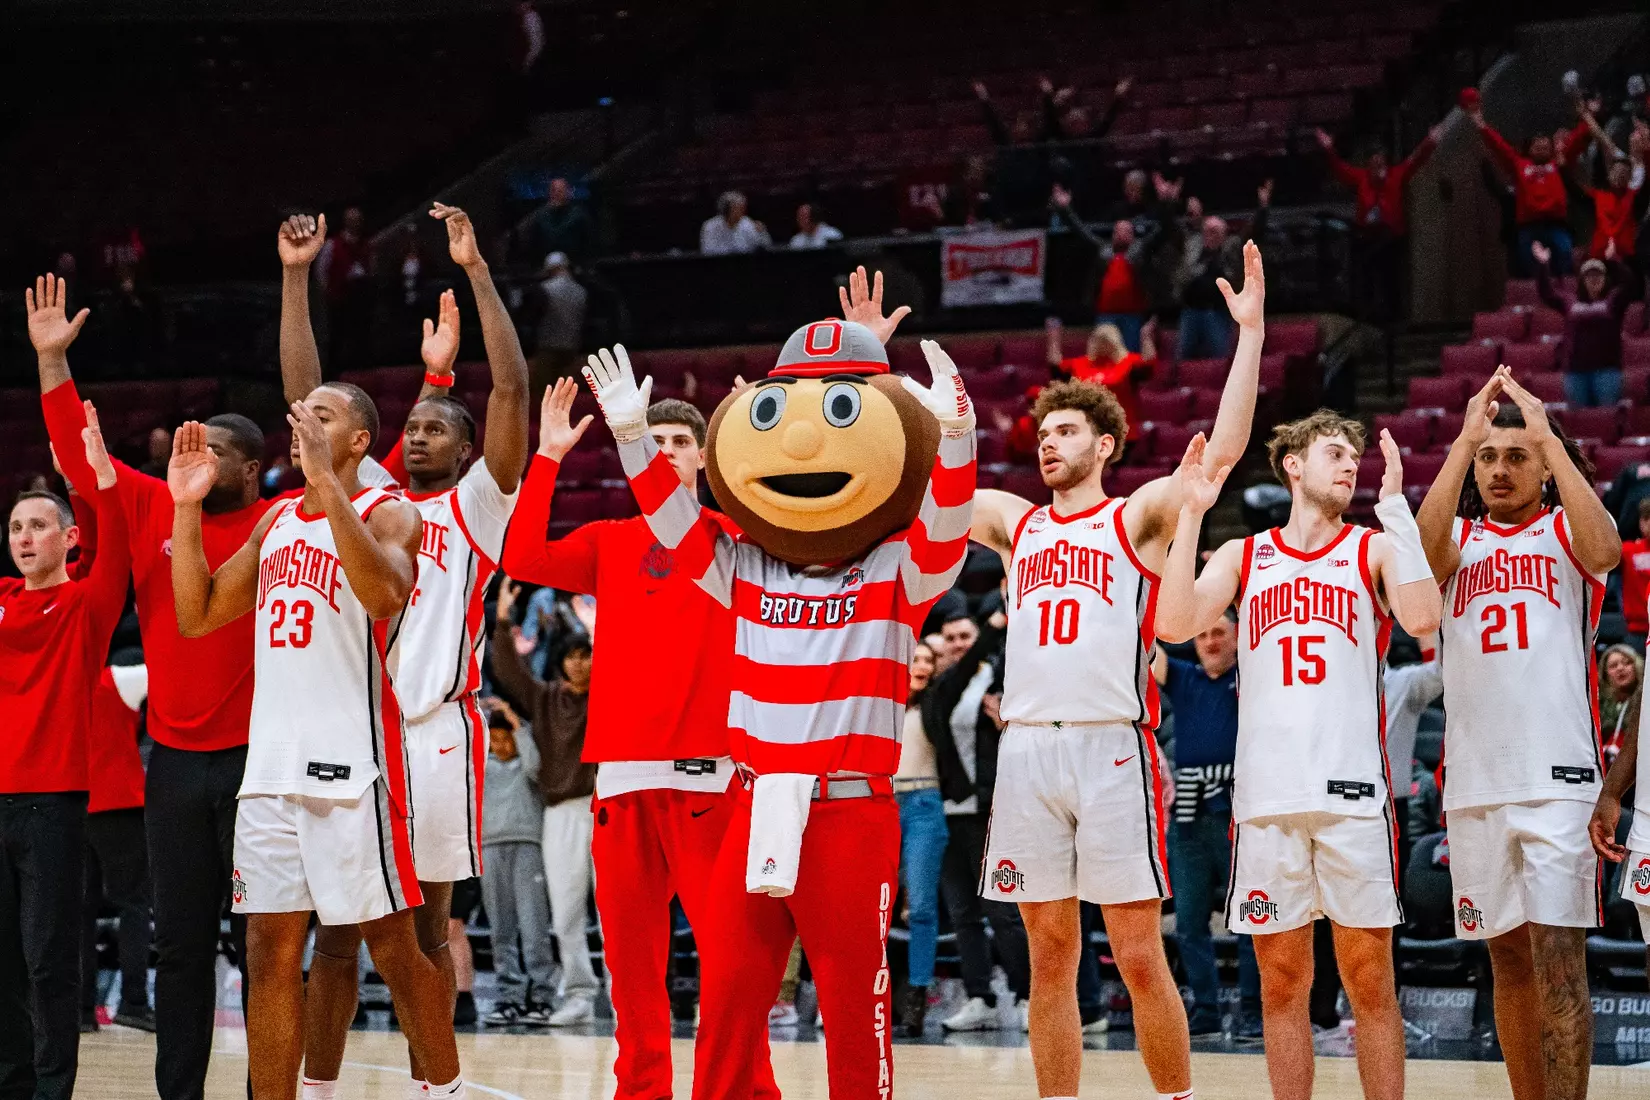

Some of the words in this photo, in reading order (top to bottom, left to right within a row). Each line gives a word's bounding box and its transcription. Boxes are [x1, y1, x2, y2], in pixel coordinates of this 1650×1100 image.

[804, 321, 844, 357] O
[270, 599, 314, 648] 23
[760, 591, 858, 626] BRUTUS
[1038, 599, 1080, 646] 10
[1481, 602, 1529, 654] 21
[1277, 636, 1326, 687] 15
[873, 882, 890, 995] OHIO
